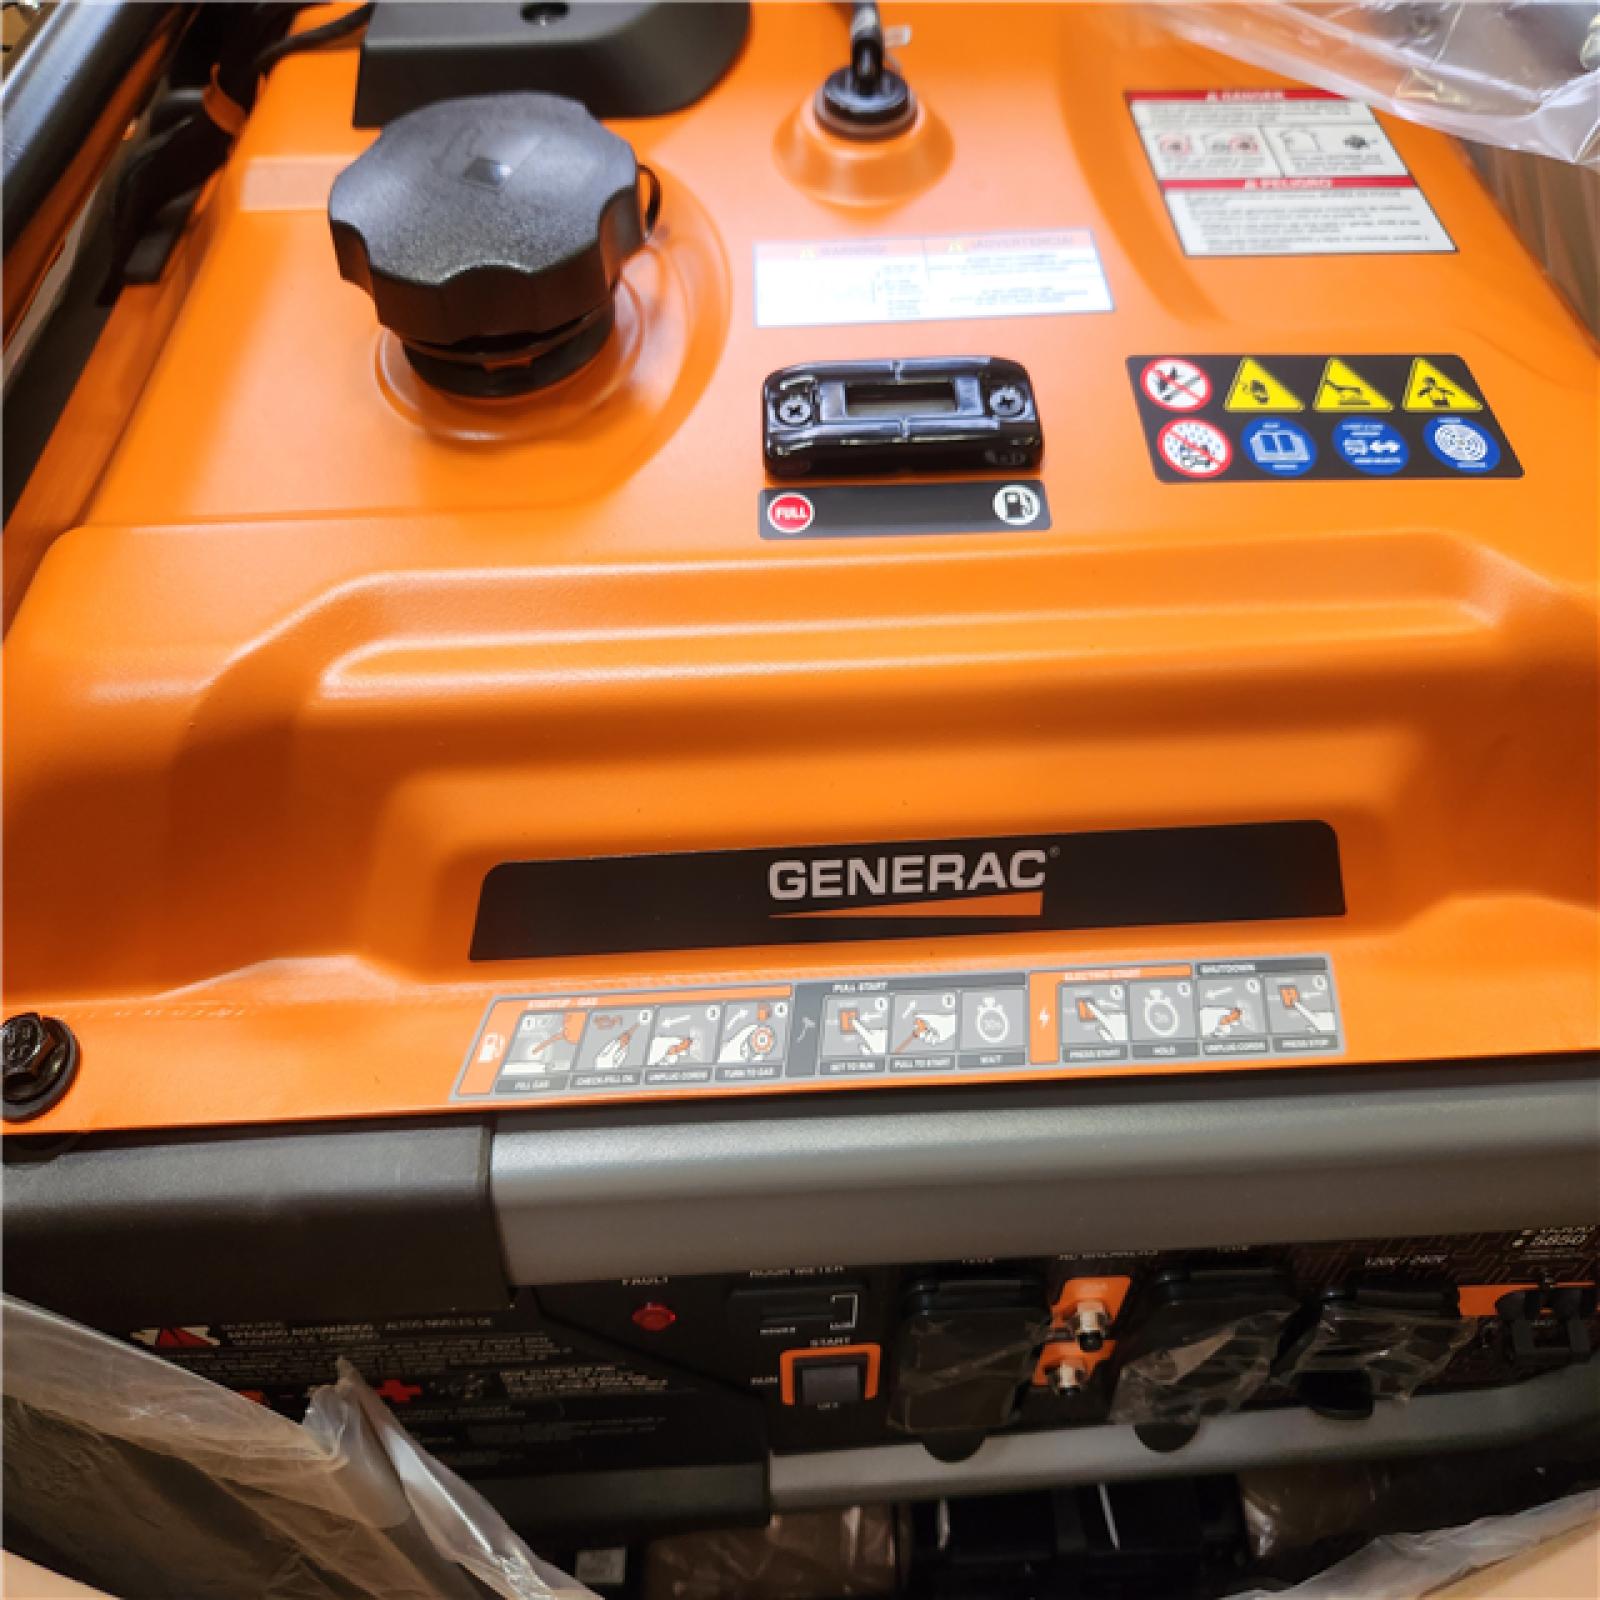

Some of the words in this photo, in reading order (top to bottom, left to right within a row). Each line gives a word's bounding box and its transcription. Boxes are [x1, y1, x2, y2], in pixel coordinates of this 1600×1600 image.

[775, 506, 809, 521] FULL
[769, 850, 1046, 900] GENERAC
[1202, 963, 1256, 975] SHUTDOWN
[832, 984, 856, 994] PULL
[859, 981, 887, 991] START
[810, 1336, 851, 1347] START
